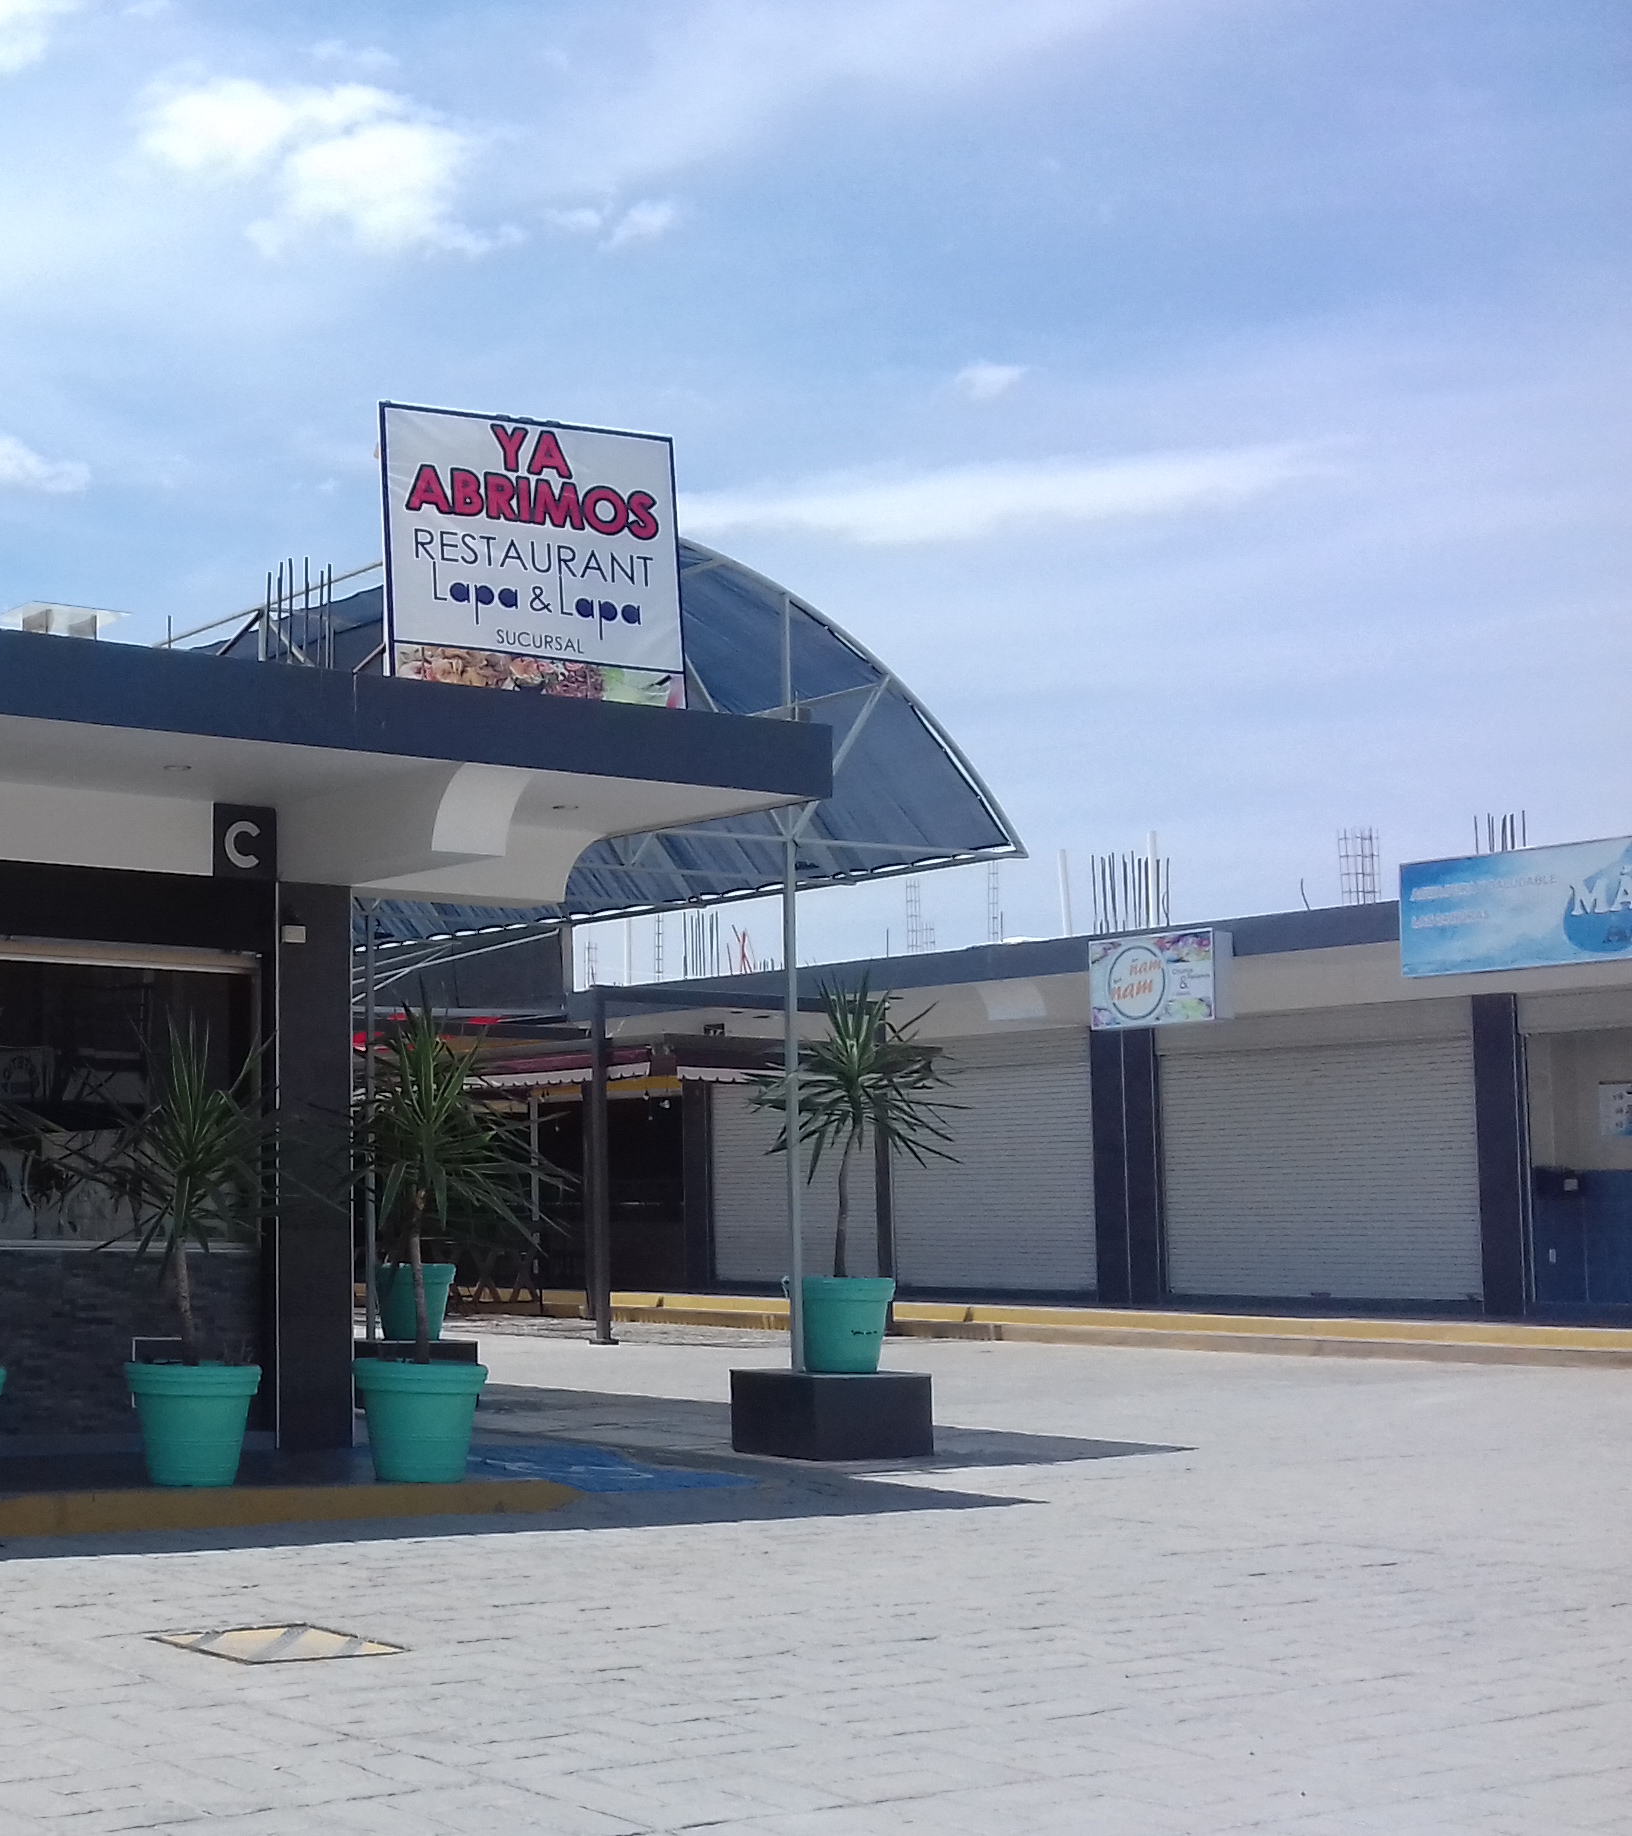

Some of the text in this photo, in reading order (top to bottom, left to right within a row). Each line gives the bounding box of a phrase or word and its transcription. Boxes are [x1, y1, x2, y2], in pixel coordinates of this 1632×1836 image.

[490, 422, 573, 480] YA
[406, 463, 659, 541] ABRIMOS
[413, 528, 654, 587] RESTAURANT
[432, 560, 642, 641] Lapa & Lapa
[495, 628, 585, 655] SUCURSAL
[224, 820, 260, 869] C
